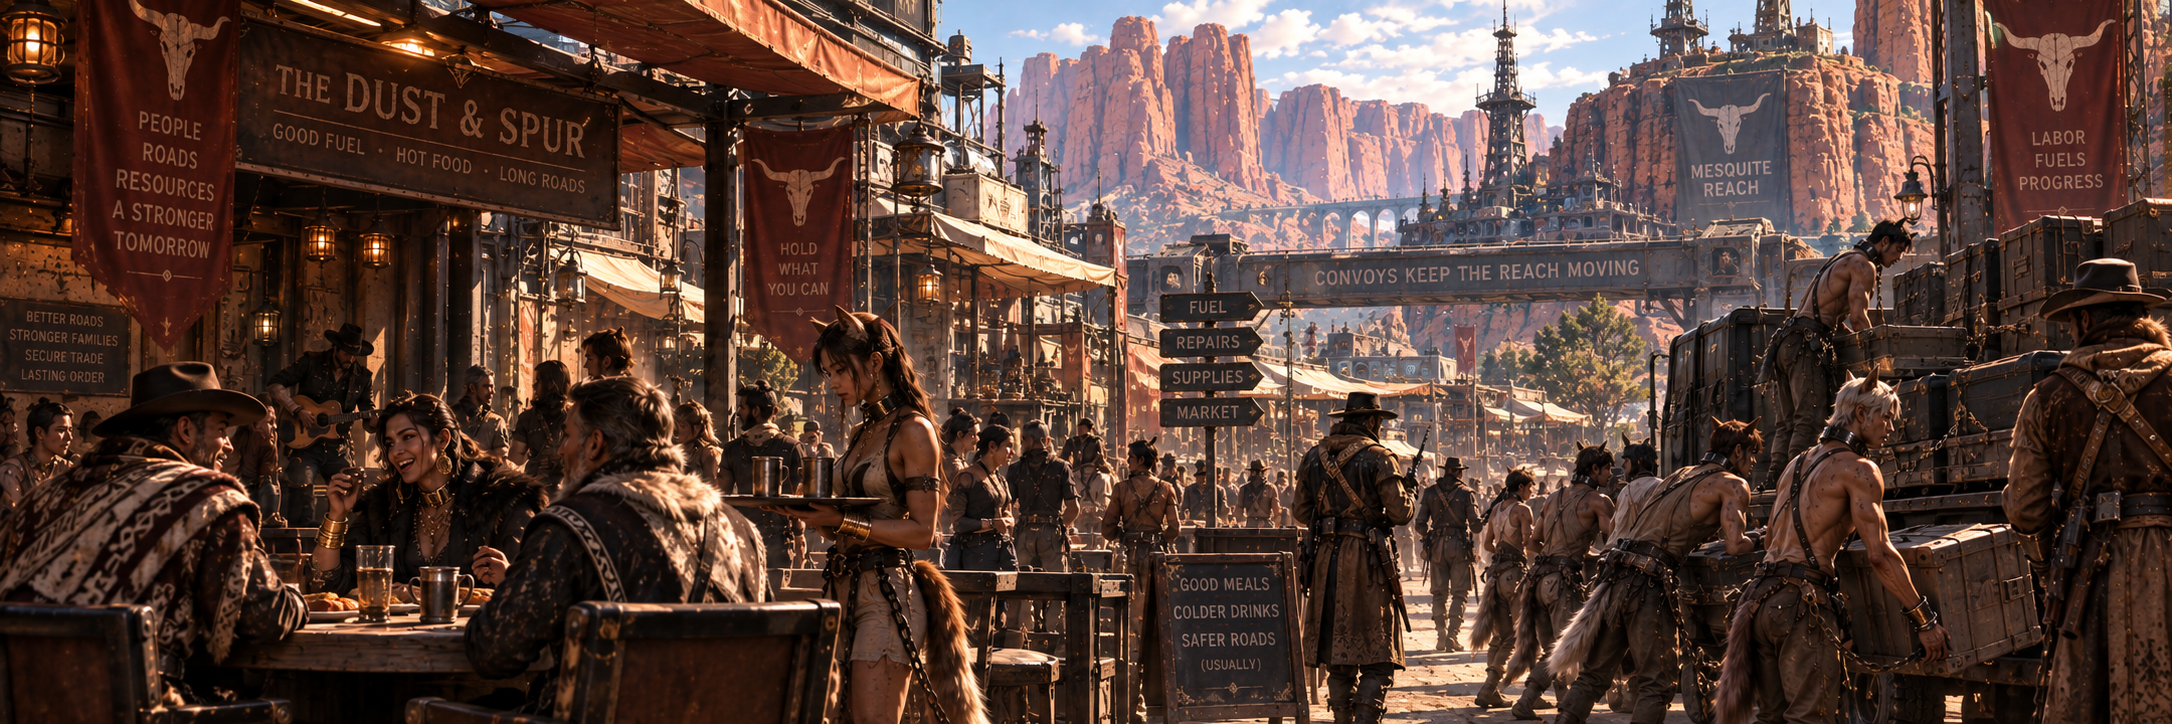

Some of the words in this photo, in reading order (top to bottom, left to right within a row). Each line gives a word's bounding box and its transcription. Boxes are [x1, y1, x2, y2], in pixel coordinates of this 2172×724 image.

[275, 64, 331, 104] THE
[344, 72, 445, 129] DUST
[459, 99, 484, 139] &
[499, 107, 585, 159] SPUR
[139, 110, 201, 141] PEOPLE
[2032, 130, 2085, 146] LABOR
[142, 142, 198, 170] ROADS
[273, 123, 319, 146] GOOD
[325, 133, 365, 155] FUEL
[396, 146, 427, 166] HOT
[432, 153, 472, 174] FOOD
[499, 166, 536, 186] LONG
[542, 173, 585, 194] ROADS
[2035, 152, 2085, 168] FUELS
[1691, 160, 1772, 179] MESQUITE
[116, 169, 214, 201] RESOURCES
[1704, 180, 1759, 197] REACH
[2019, 174, 2103, 191] PROGRESS
[112, 200, 124, 219] A
[132, 203, 214, 231] STRONGER
[114, 231, 210, 259] TOMORROW
[780, 242, 818, 255] HOLD
[779, 262, 818, 275] WHAT
[1315, 268, 1398, 286] CONVOYS
[1405, 266, 1450, 283] KEEP
[1457, 264, 1491, 281] THE
[1500, 262, 1559, 280] REACH
[1568, 259, 1639, 278] MOVING
[768, 283, 795, 296] YOU
[801, 282, 828, 295] CAN
[1189, 300, 1227, 314] FUEL
[26, 311, 66, 324] BETTER
[69, 314, 104, 327] ROADS
[10, 329, 67, 343] STRONGER
[72, 333, 118, 347] FAMILIES
[1176, 335, 1240, 349] REPAIRS
[25, 349, 67, 362] SECURE
[70, 352, 104, 364] TRADE
[22, 369, 66, 381] LASTING
[69, 371, 105, 383] ORDER
[1172, 370, 1244, 385] SUPPLIES
[1177, 405, 1239, 419] MARKET
[1180, 578, 1218, 591] GOOD
[1224, 577, 1270, 591] MEALS
[1174, 605, 1226, 619] COLDER
[1231, 604, 1279, 618] DRINKS
[1182, 633, 1226, 647] SAFER
[1231, 632, 1276, 646] ROADS
[1201, 658, 1261, 672] (USUALLY)
